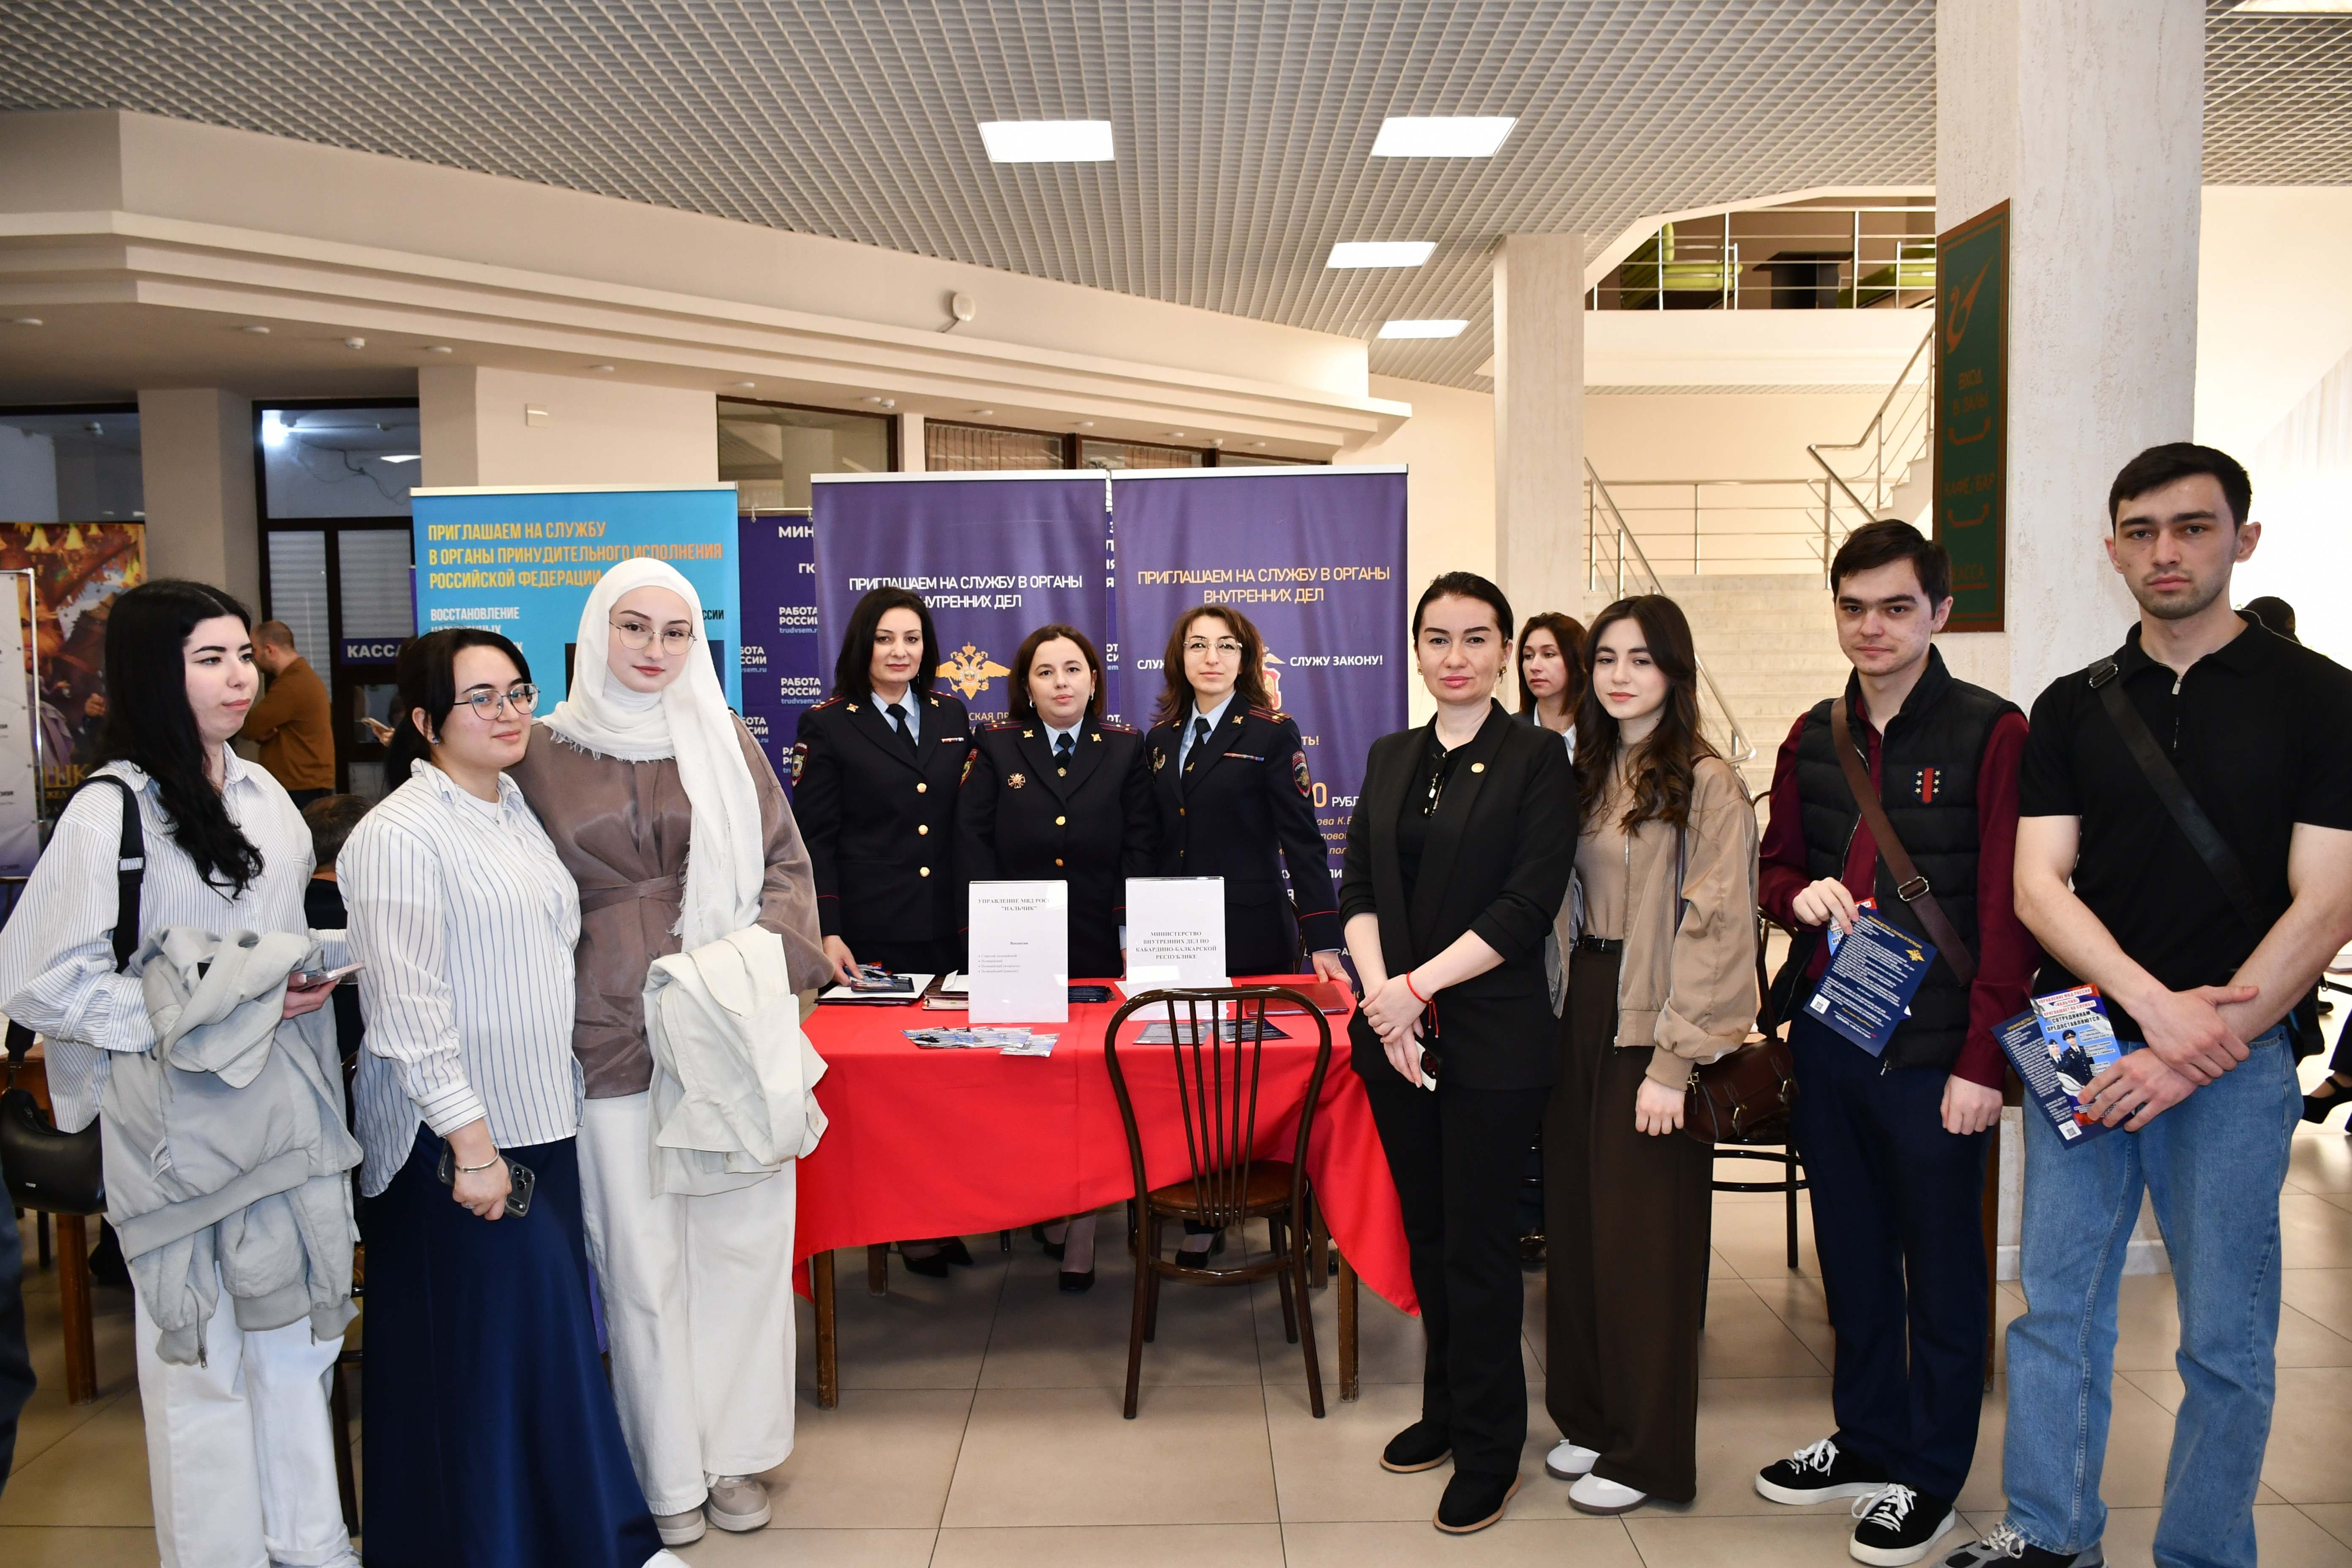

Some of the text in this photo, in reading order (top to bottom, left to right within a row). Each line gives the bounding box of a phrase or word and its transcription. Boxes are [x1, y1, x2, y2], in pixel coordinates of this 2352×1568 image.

[428, 522, 606, 541] ПРИГЛАШАЕМ НА СЛУЖБУ
[430, 544, 722, 565] В ОРГАНЫ ПРИНУДИТЕЛЬНОГО ИСПОЛНЕНИЯ
[430, 569, 602, 589] РОССИЙСКОЙ ФЕДЕРАЦИИ
[1138, 566, 1390, 584] ПРИГЛАШАЕМ НА СЛУЖБУ В ОРГАНЫ
[849, 575, 1082, 591] ПРИГЛАШАЕМ НА СЛУЖБУ В ОРГАНЫ
[921, 595, 1021, 610] НУТРЕННИХ ДЕЛ
[1204, 588, 1324, 604] ВНУТРЕННИХ ДЕЛ
[430, 607, 520, 621] ВОССТАНОВЛЕНИЕ
[779, 607, 817, 615] РАБОТА
[1290, 656, 1330, 666] СЛУЖУ
[1333, 655, 1383, 666] ЗАКОНУ!
[781, 678, 821, 686] РАБОТА
[2052, 1010, 2091, 1023] СОТРУДНИКАМ
